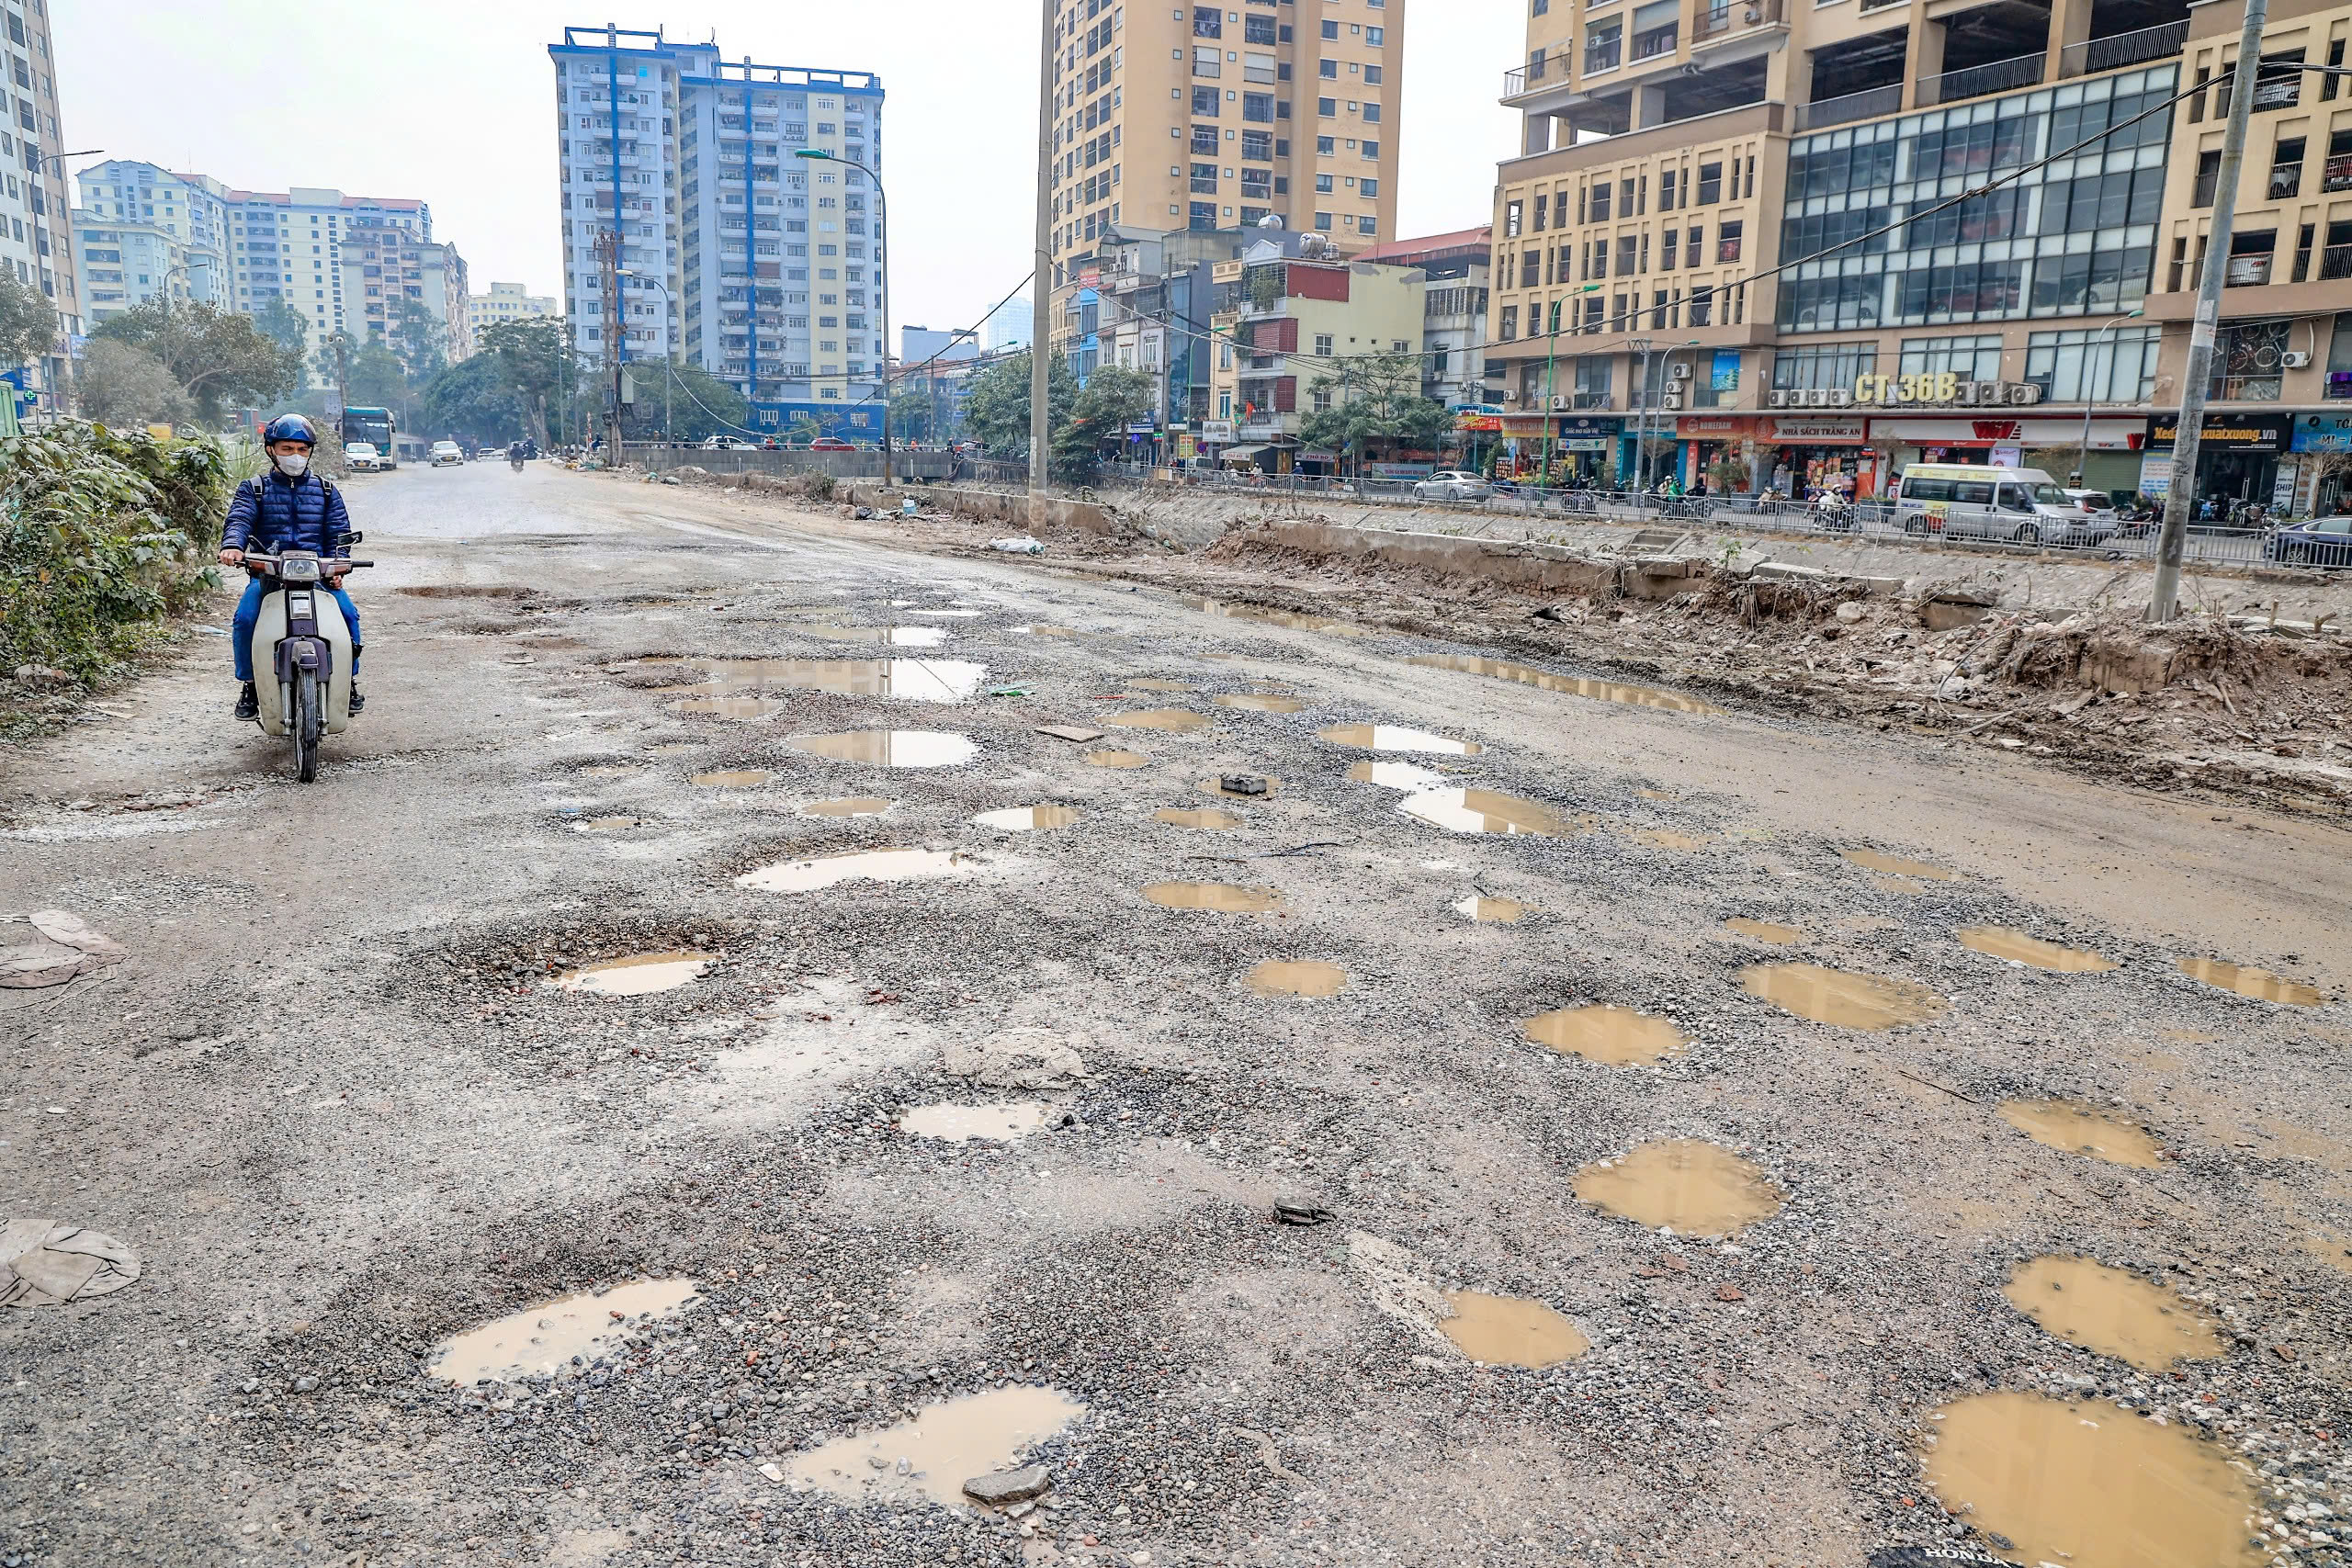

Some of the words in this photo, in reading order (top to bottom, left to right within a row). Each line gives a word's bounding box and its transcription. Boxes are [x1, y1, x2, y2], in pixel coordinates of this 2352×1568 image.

[1855, 374, 1890, 402] CT
[1898, 372, 1957, 402] 36B
[1782, 426, 1798, 435] NHÀ
[1800, 426, 1819, 435] SÁCH
[2275, 483, 2293, 491] SHIP
[1922, 1548, 2012, 1568] HONDA
